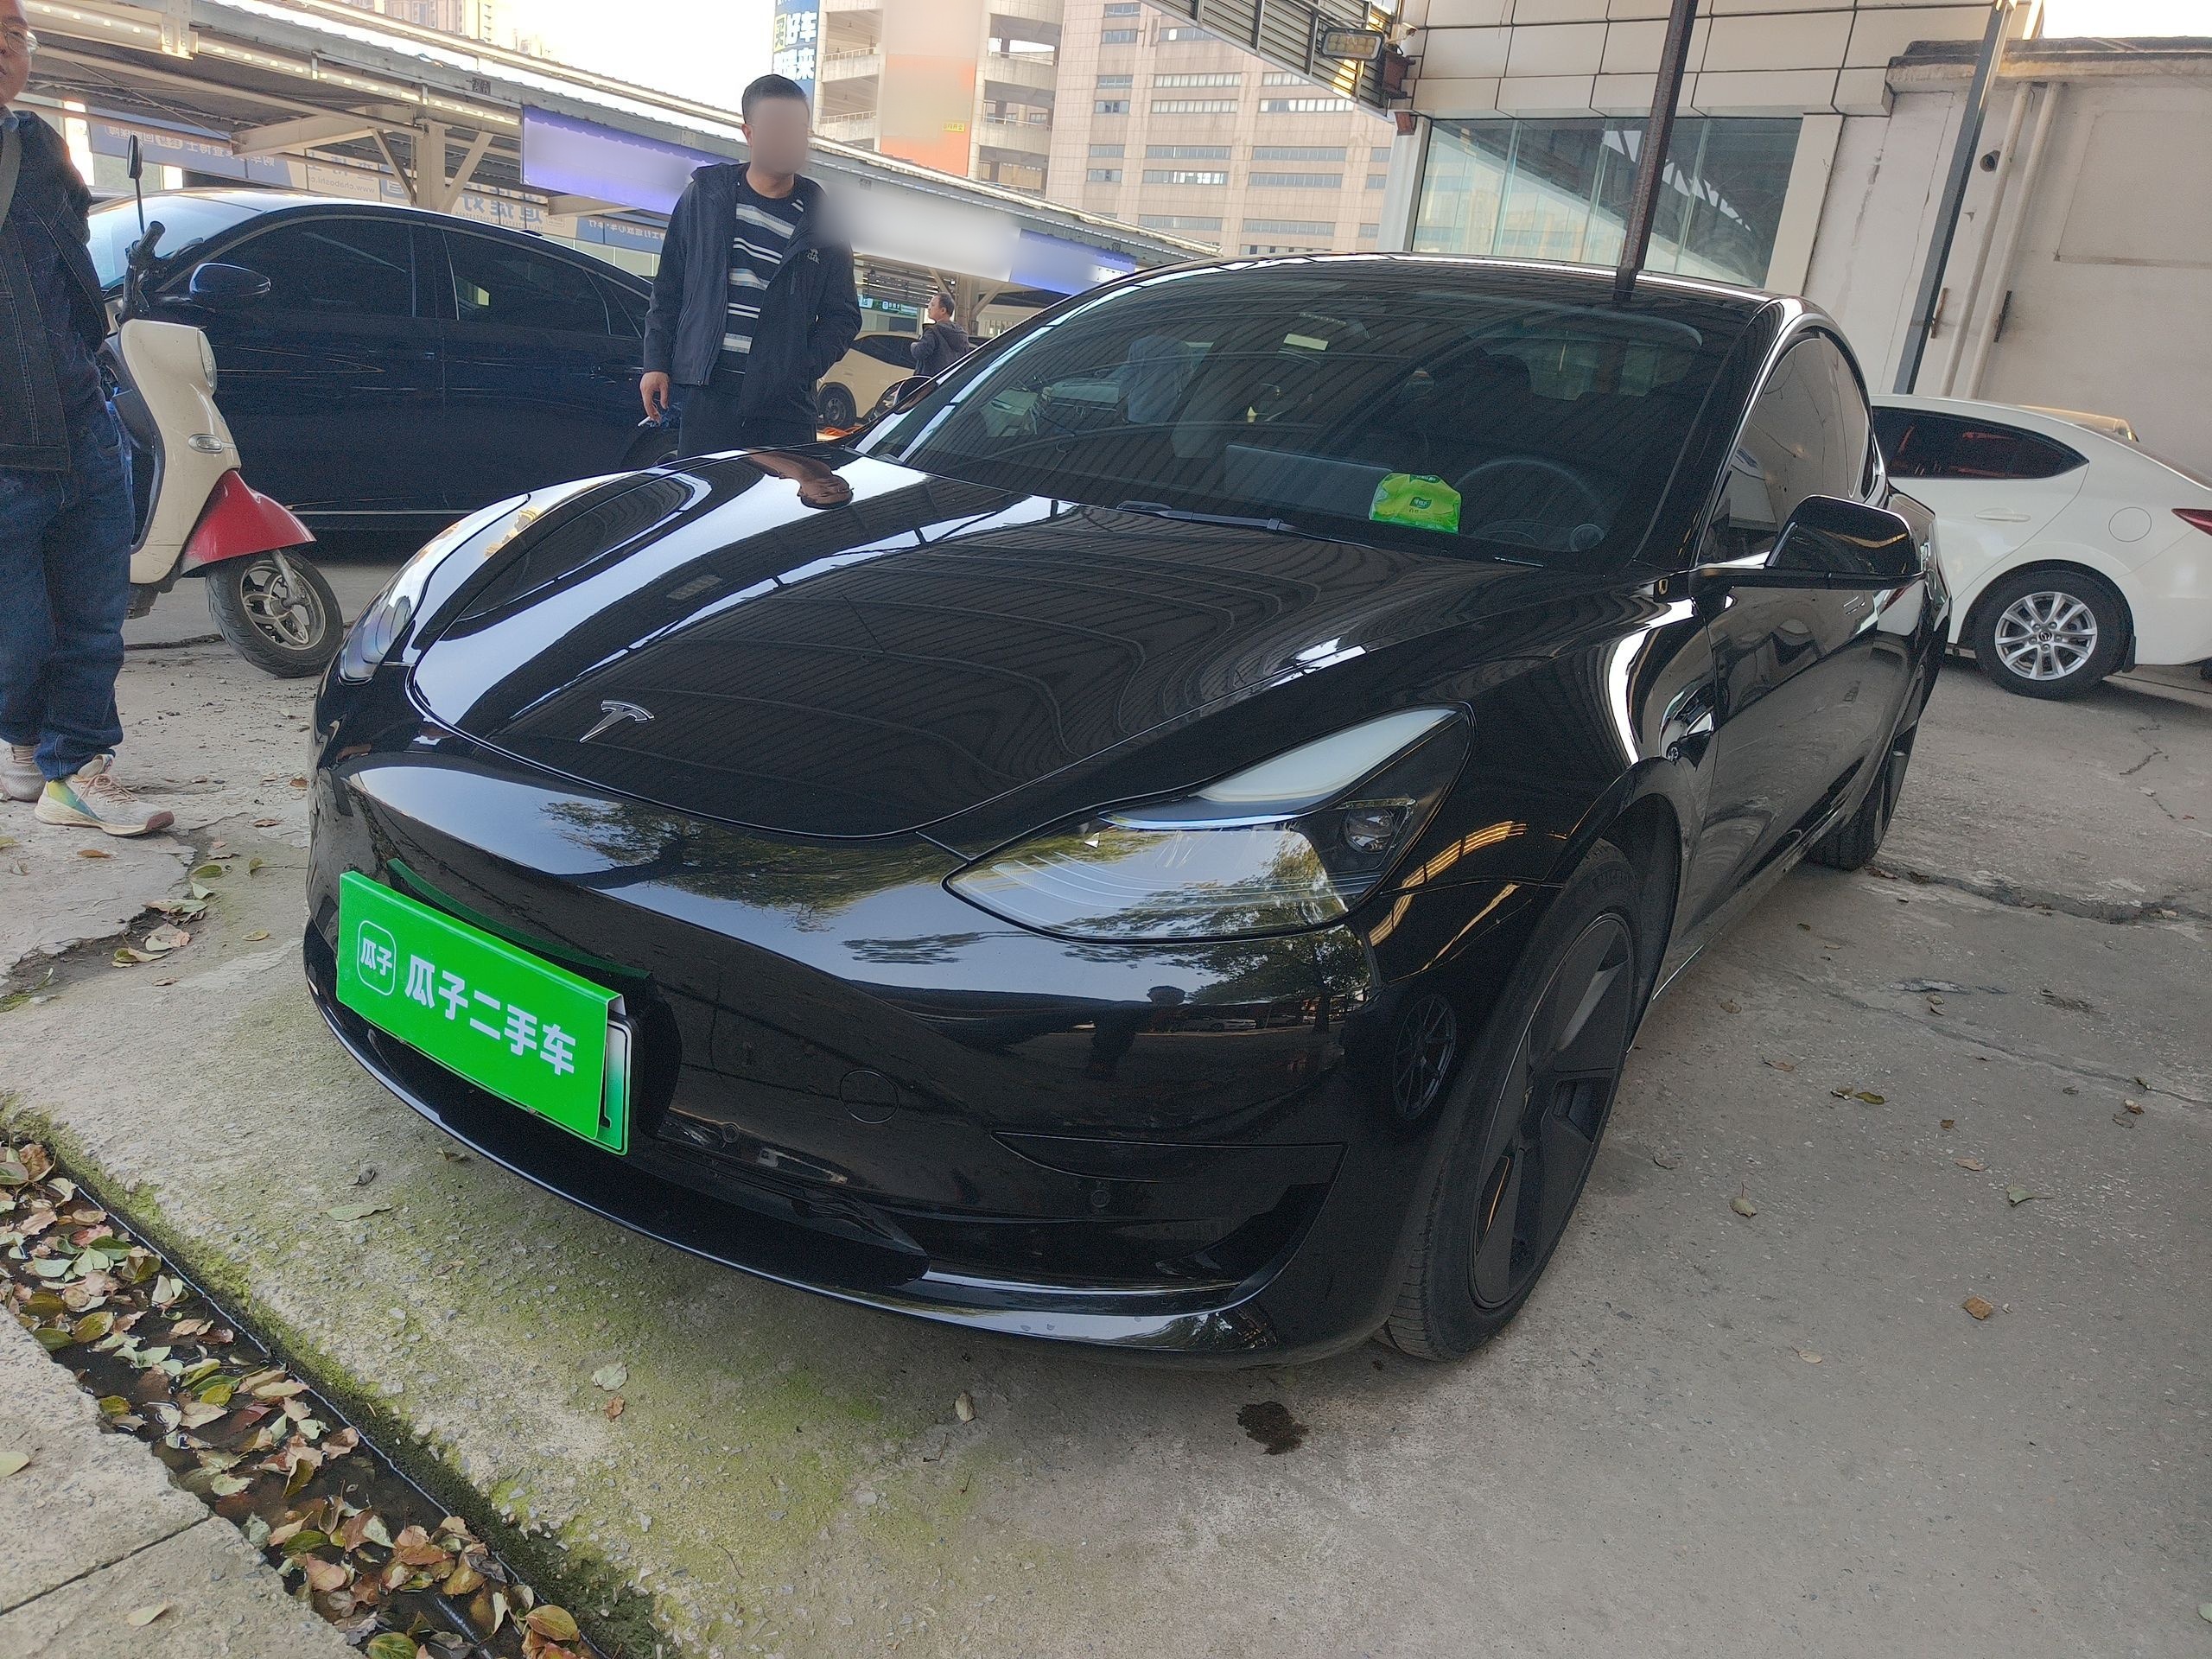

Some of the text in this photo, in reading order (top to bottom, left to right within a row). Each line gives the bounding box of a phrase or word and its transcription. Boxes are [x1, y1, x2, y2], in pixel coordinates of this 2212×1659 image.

[774, 10, 818, 48] 买好车
[360, 938, 392, 976] 瓜子
[405, 954, 576, 1076] 瓜子二手车
